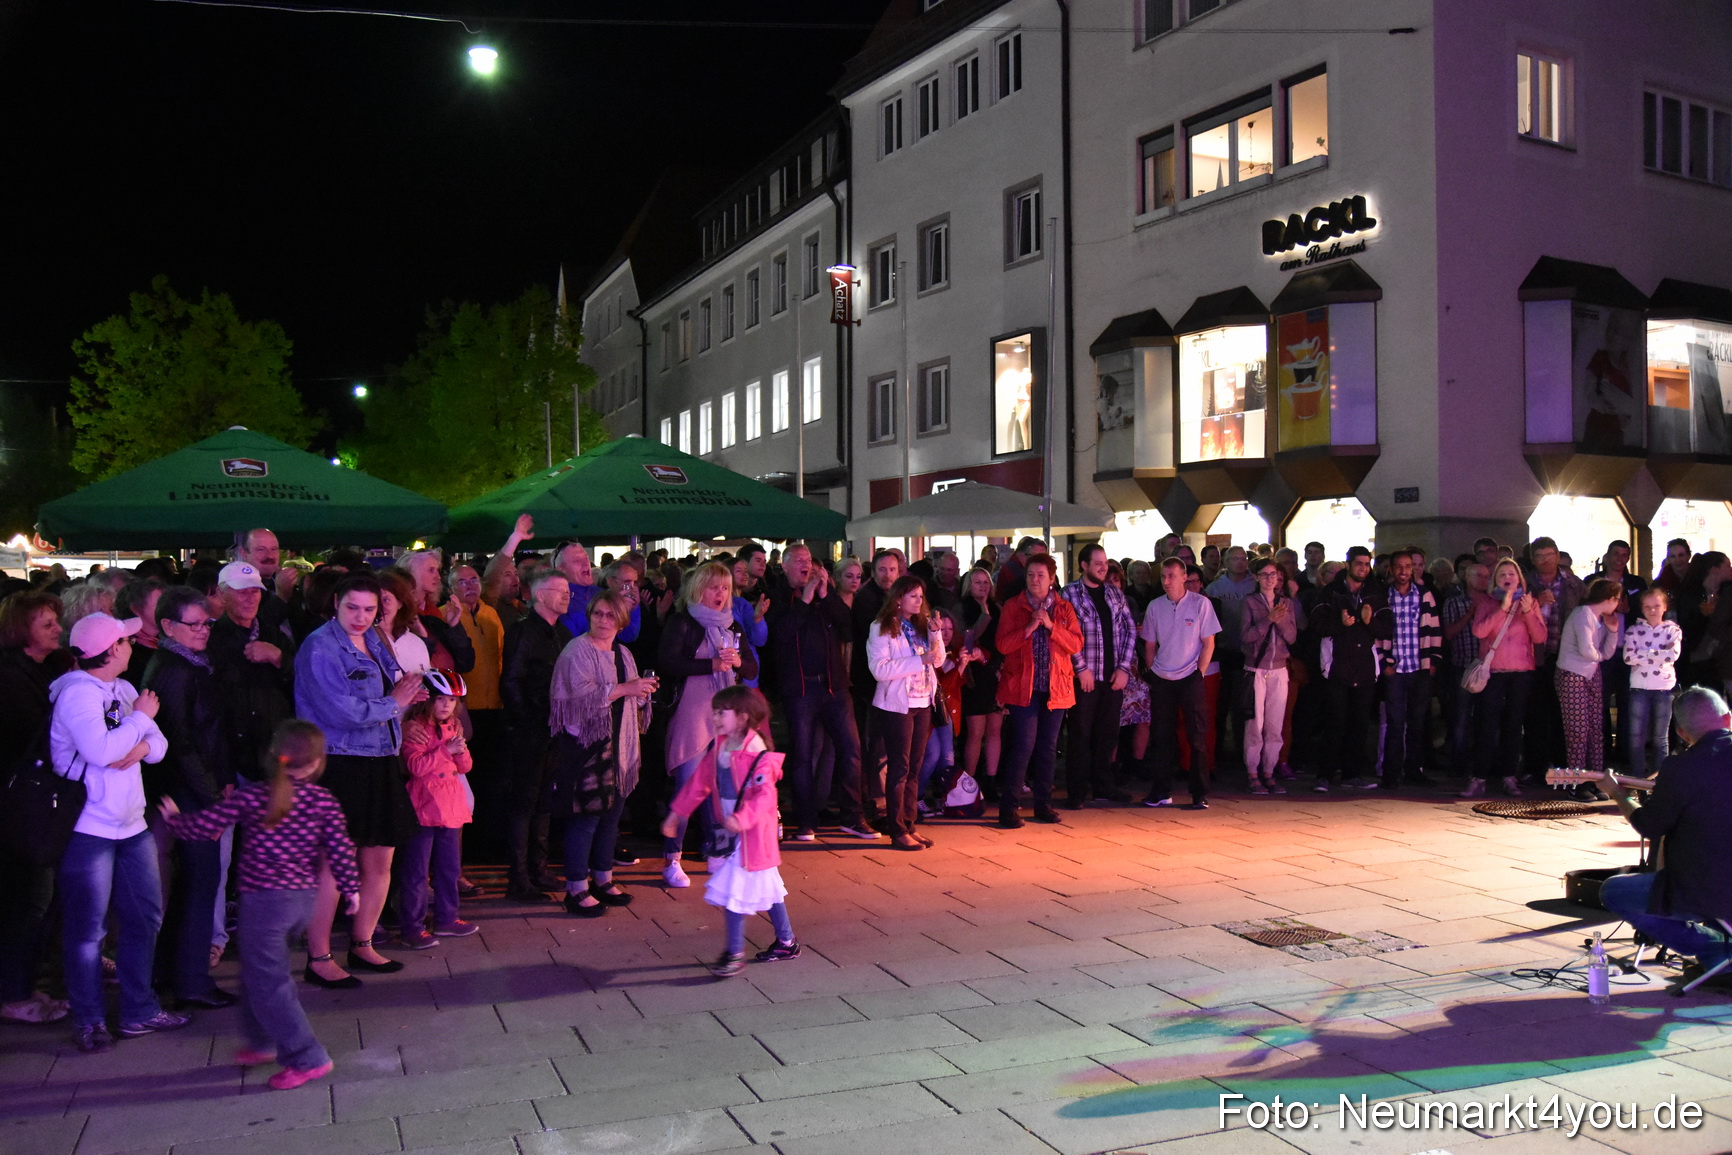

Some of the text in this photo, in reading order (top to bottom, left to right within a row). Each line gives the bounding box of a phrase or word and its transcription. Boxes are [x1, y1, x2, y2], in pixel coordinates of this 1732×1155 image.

[1262, 195, 1377, 255] BACKL
[1280, 239, 1366, 271] am Rathaus
[834, 277, 848, 321] Achatz
[191, 482, 307, 491] Neumarkter
[632, 487, 727, 497] Neumarkter
